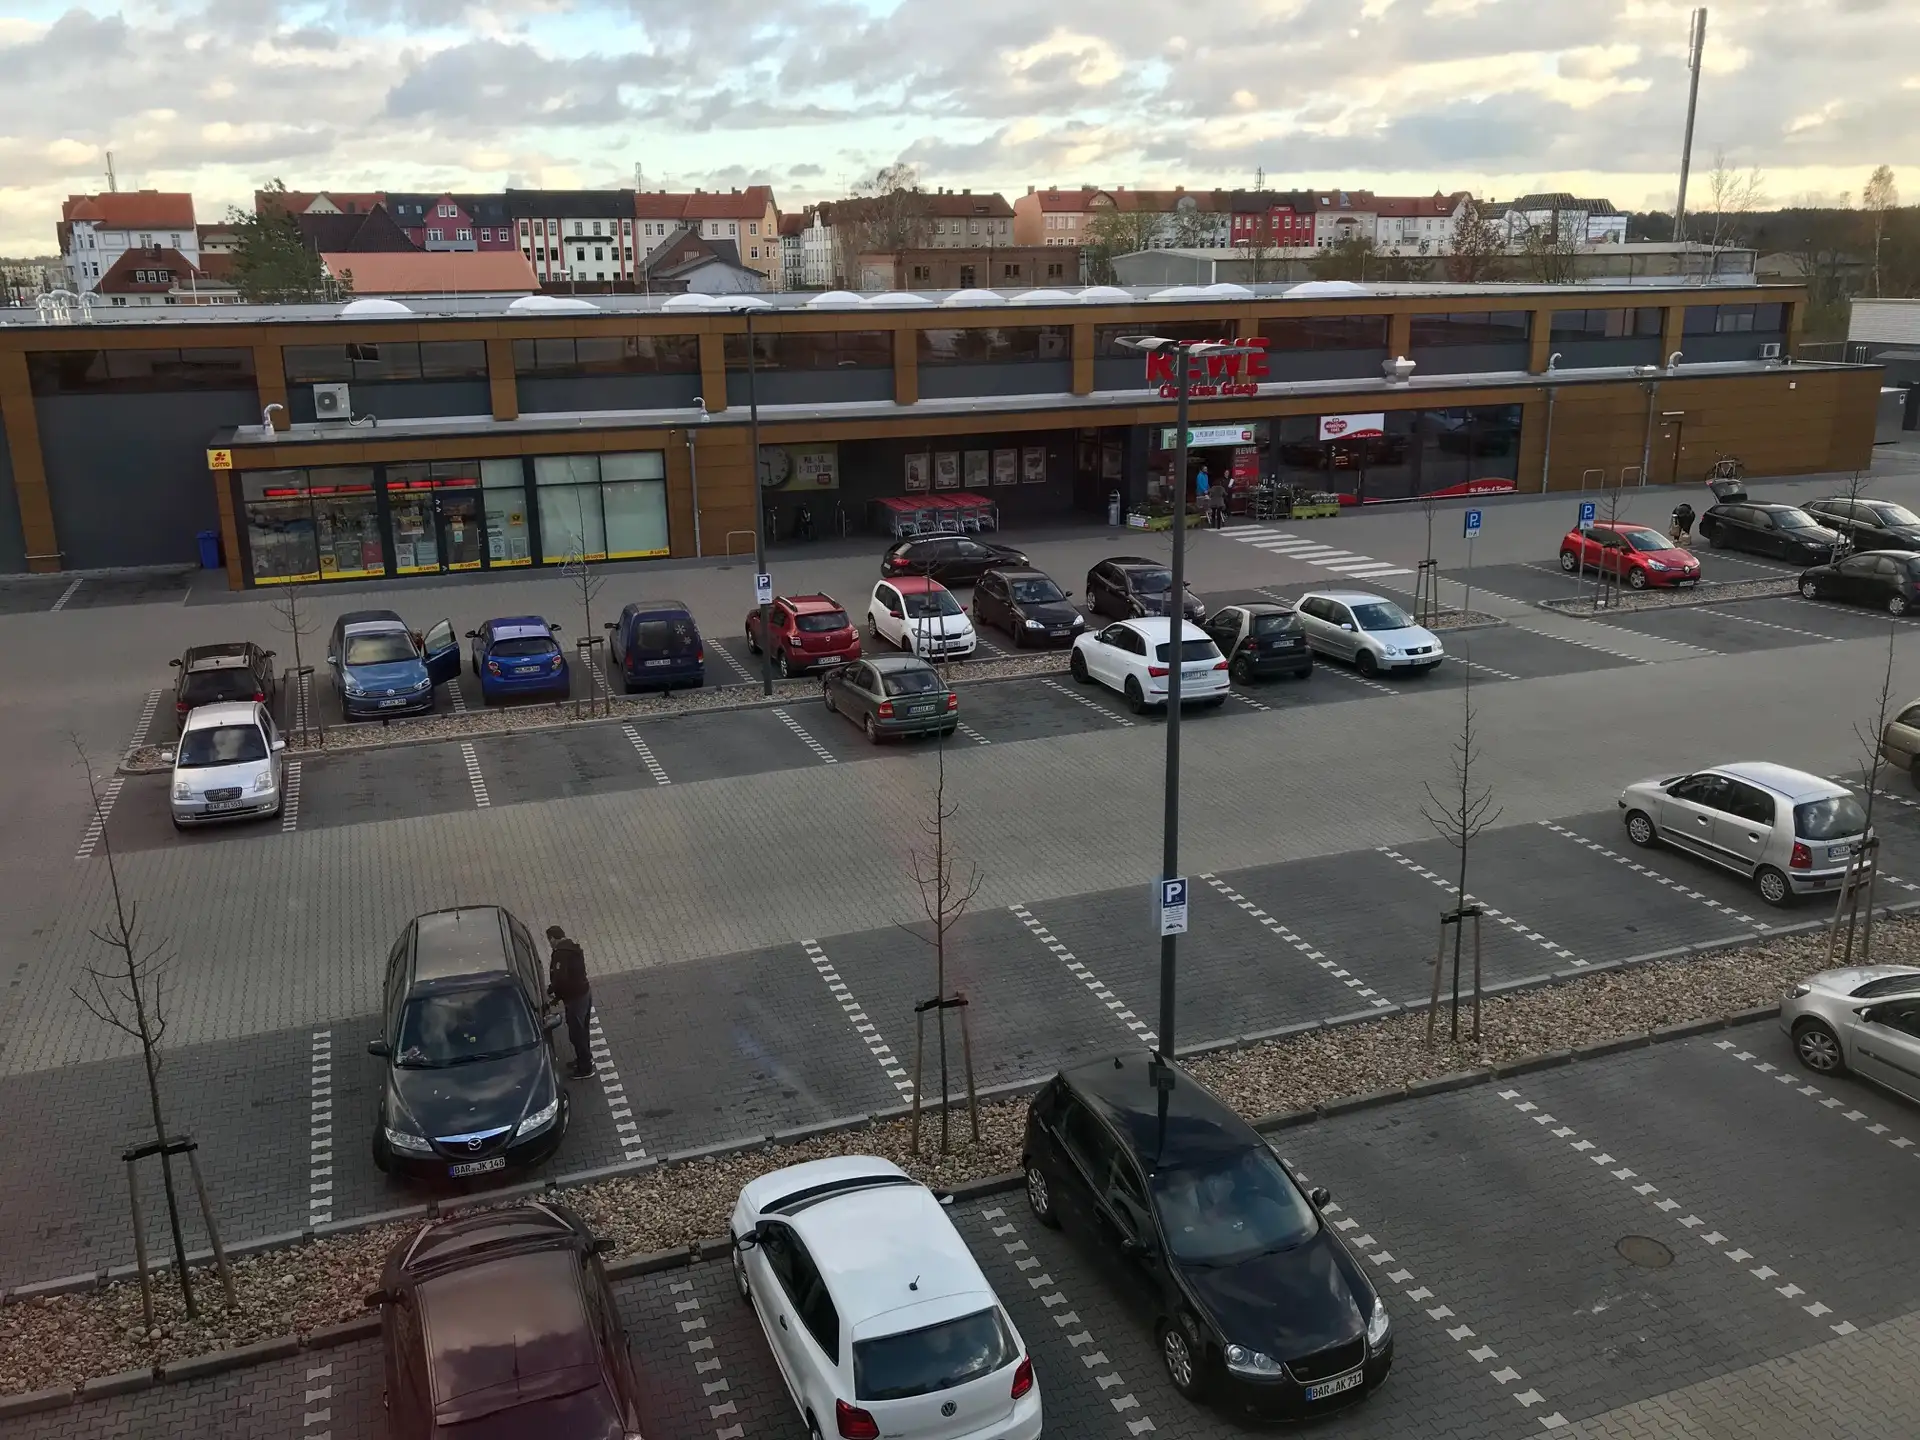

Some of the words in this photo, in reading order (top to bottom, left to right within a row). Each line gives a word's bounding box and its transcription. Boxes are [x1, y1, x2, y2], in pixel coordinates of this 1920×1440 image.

[1235, 446, 1257, 455] REWE
[1583, 505, 1592, 518] P
[1469, 513, 1478, 527] P
[759, 576, 769, 587] P
[1166, 882, 1183, 903] P
[454, 1165, 471, 1174] BAR
[477, 1162, 488, 1171] JK
[490, 1159, 504, 1168] 148
[1313, 1385, 1330, 1398] BAR
[1336, 1379, 1347, 1391] AK
[1348, 1373, 1362, 1387] 711
